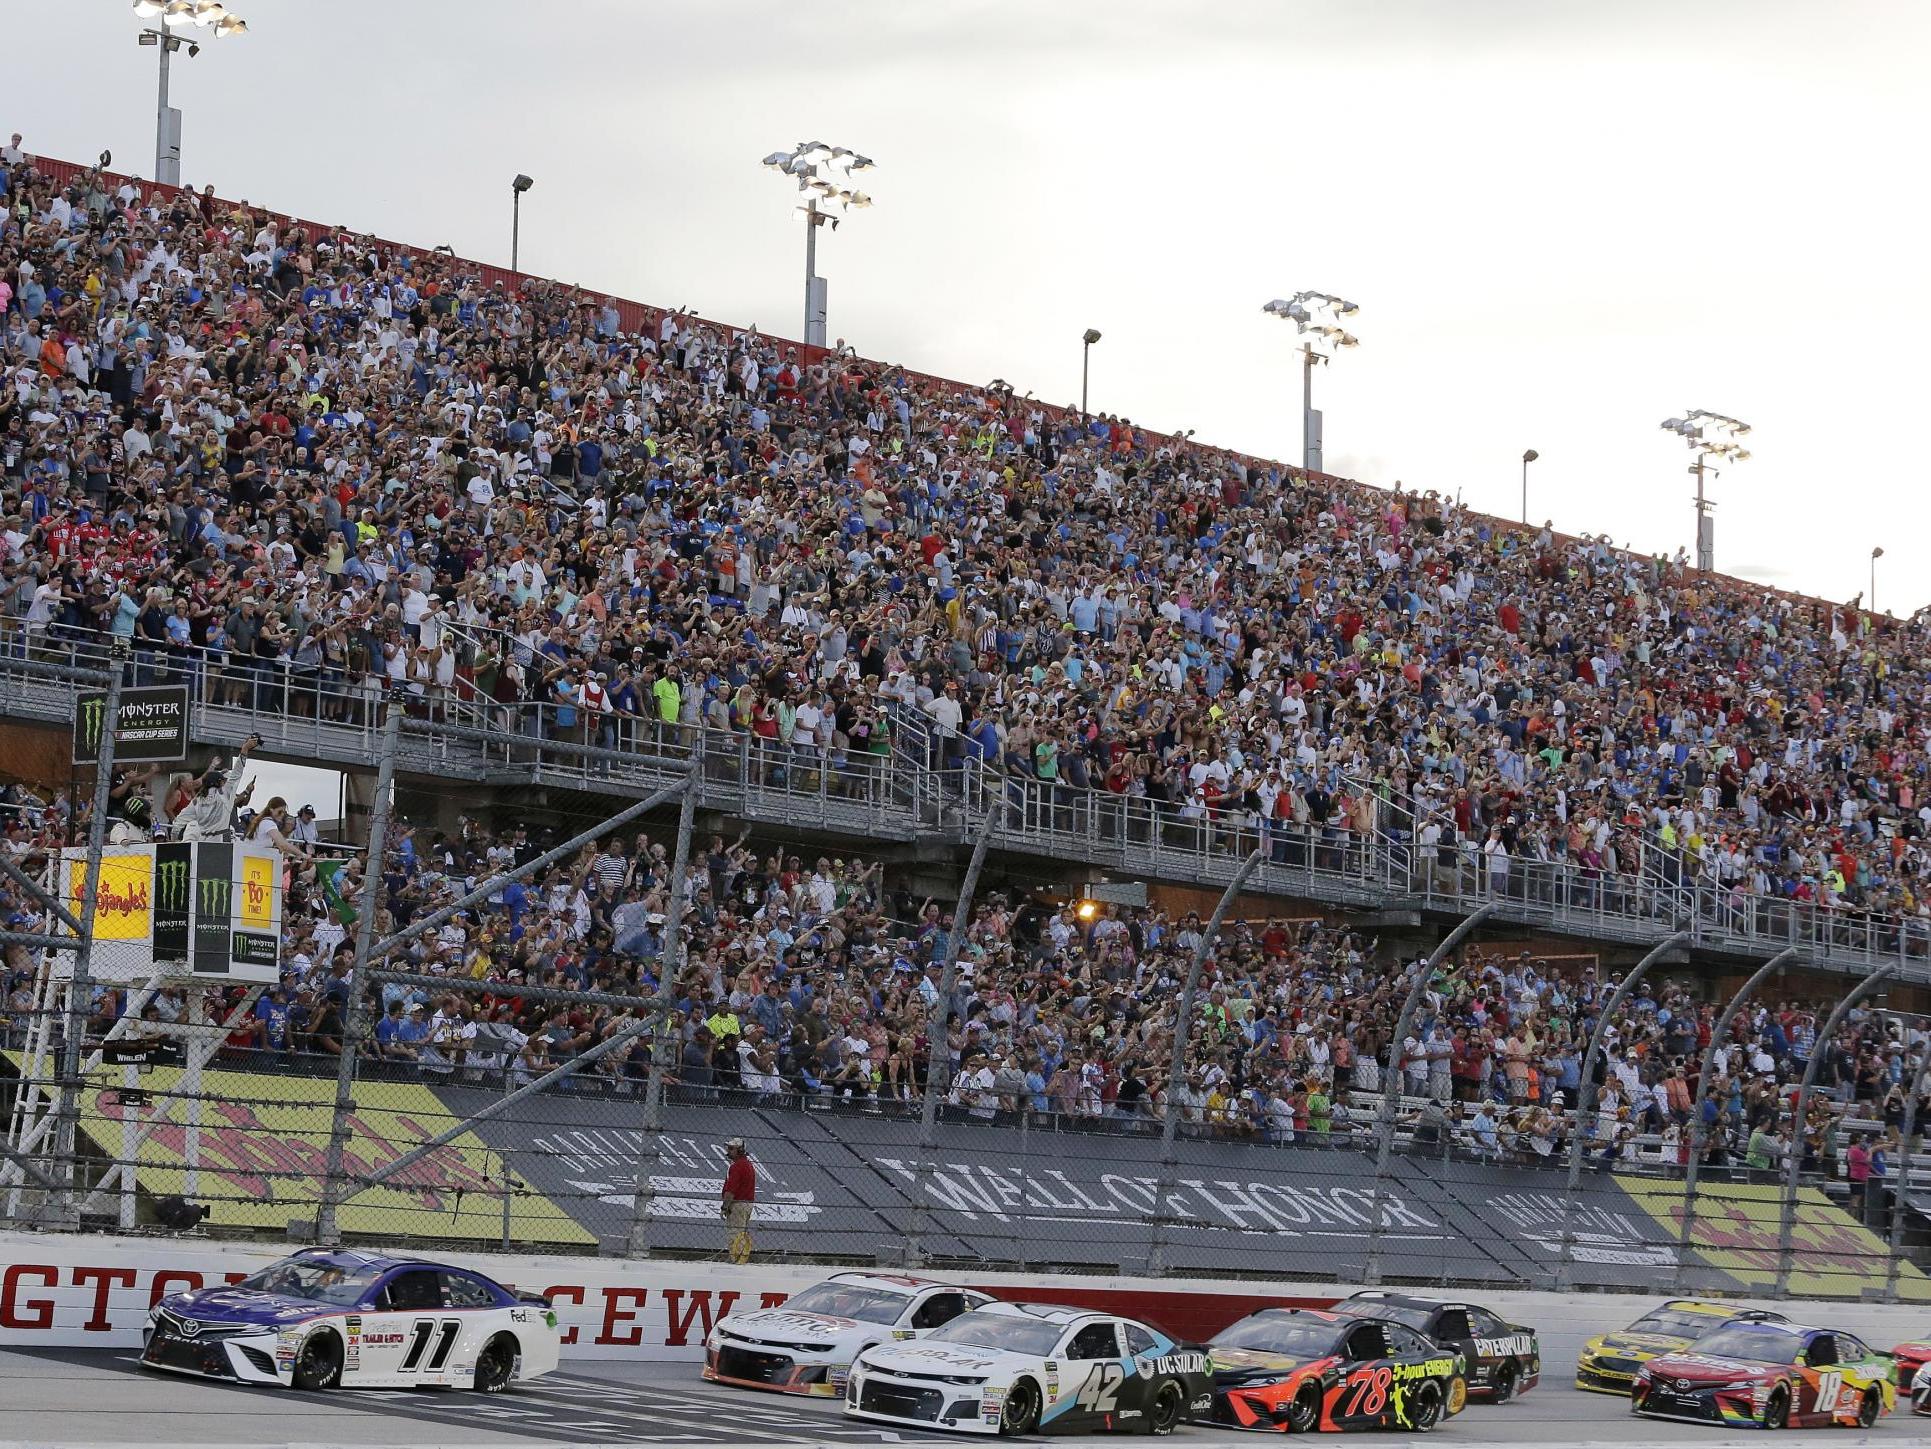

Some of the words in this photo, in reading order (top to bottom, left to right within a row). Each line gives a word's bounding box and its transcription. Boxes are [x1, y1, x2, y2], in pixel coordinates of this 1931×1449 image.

[117, 702, 180, 718] MONSTER
[123, 719, 170, 727] ENERGY
[121, 731, 145, 740] NASCAR
[145, 730, 157, 738] CUP
[157, 729, 179, 738] SERIES
[156, 920, 187, 928] MONSTER
[197, 923, 230, 931] MONSTER
[248, 939, 275, 948] MONSTER
[117, 1053, 147, 1062] WHELEN
[875, 1157, 1120, 1221] WALL
[1101, 1172, 1197, 1218] OF
[1182, 1178, 1441, 1237] HONOR
[646, 1200, 785, 1217] RACEAY
[164, 1334, 213, 1345] CAMRY
[348, 1336, 359, 1345] 3M
[397, 1317, 463, 1373] 11
[1473, 1335, 1532, 1357] CATERPILLAR
[1157, 1356, 1176, 1375] DC
[1175, 1353, 1205, 1374] SOLAR
[1393, 1362, 1425, 1381] 5-hour
[1425, 1359, 1453, 1377] ENERGY
[1076, 1362, 1126, 1412] 42
[1345, 1367, 1392, 1417] 78
[1812, 1371, 1842, 1413] 18
